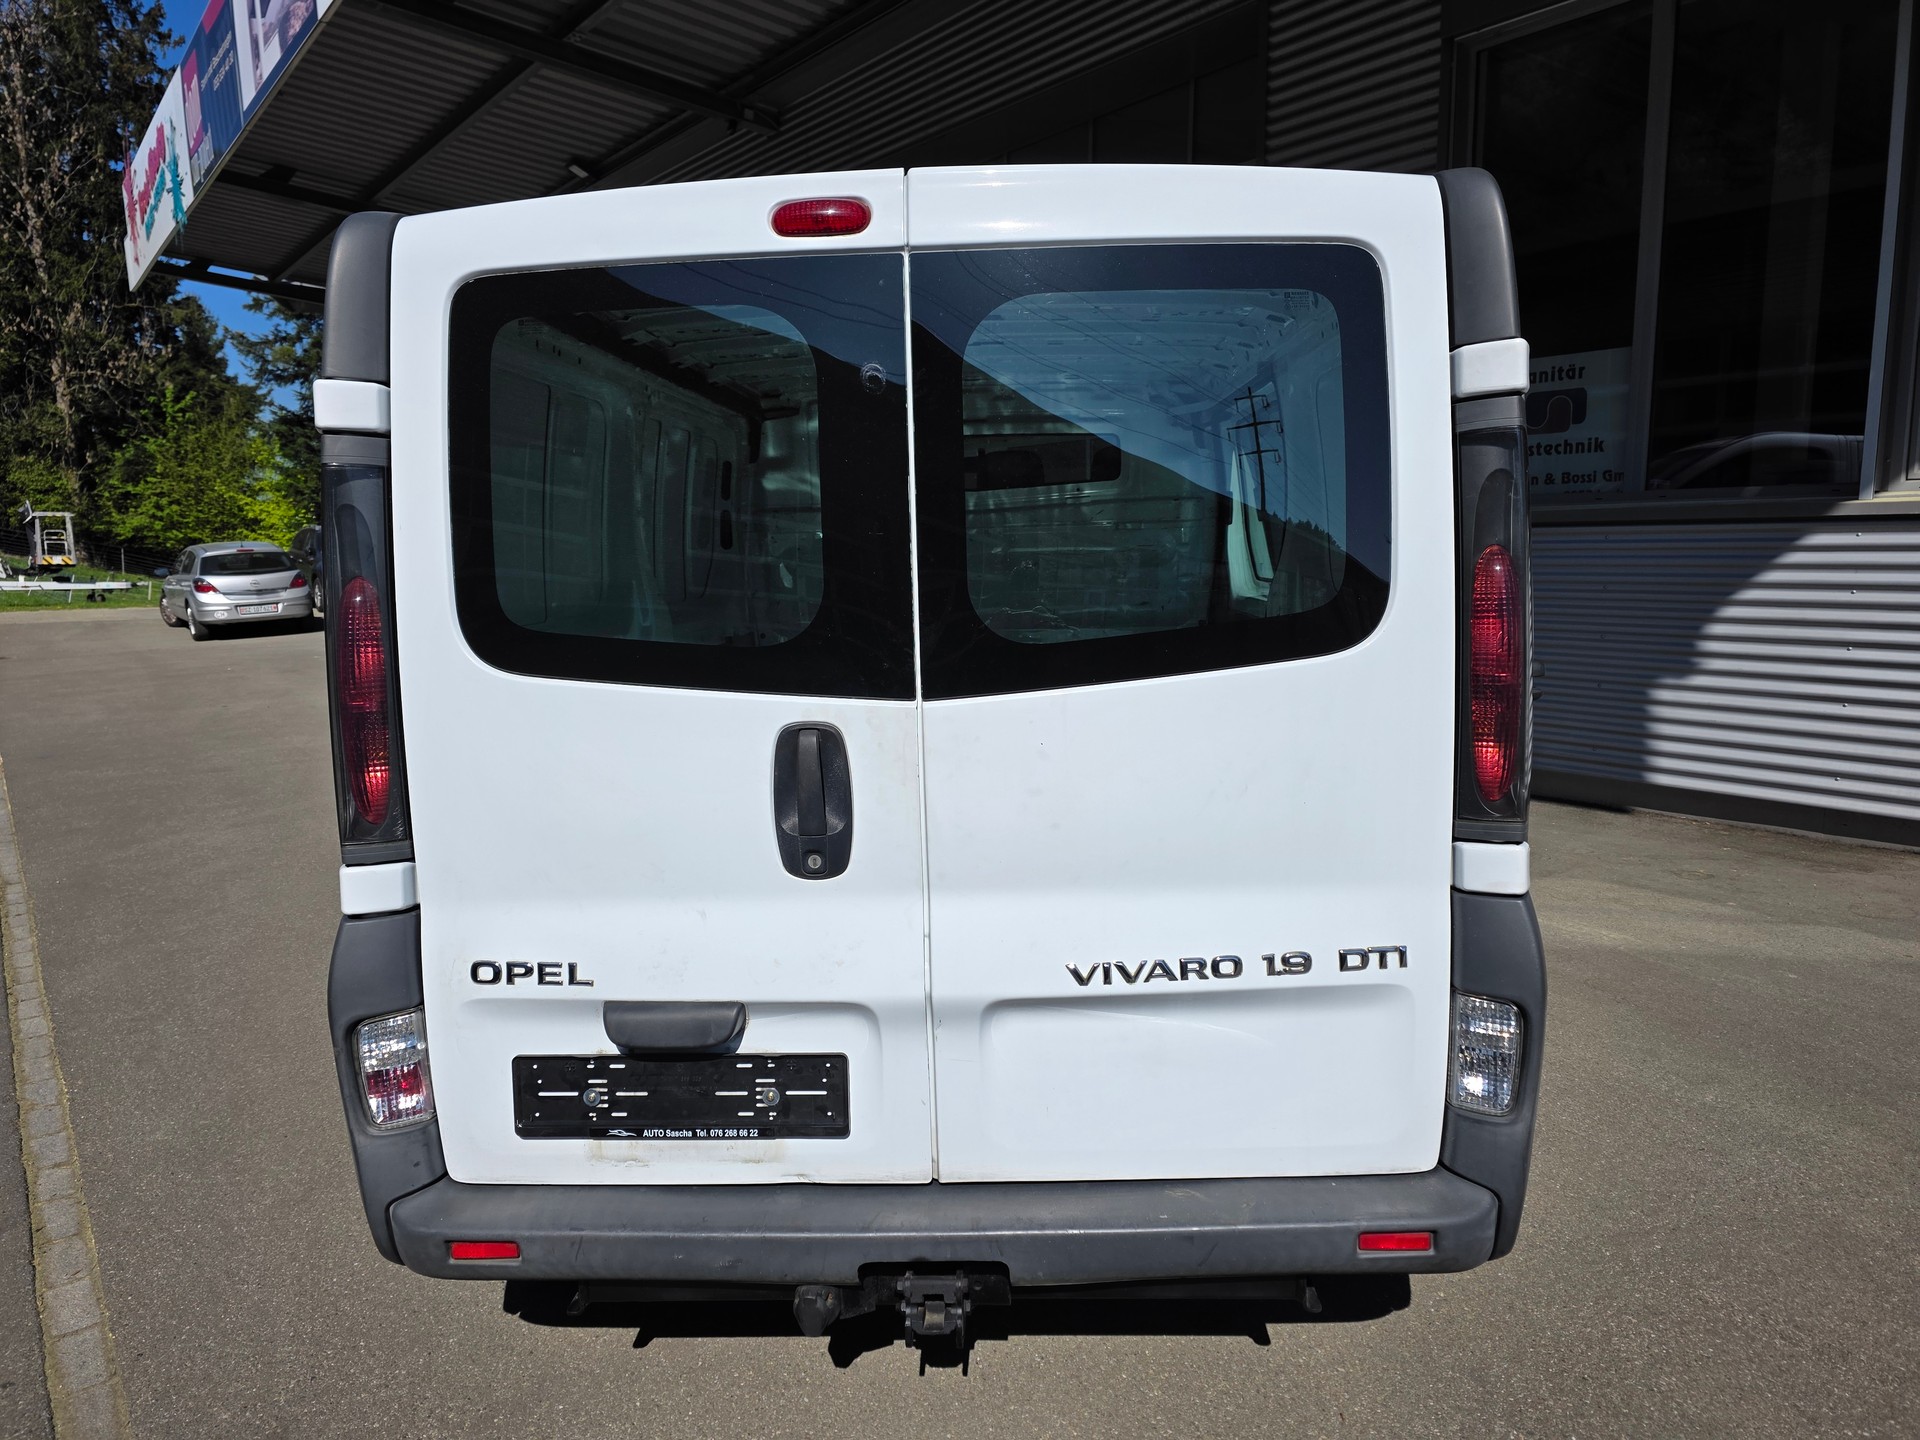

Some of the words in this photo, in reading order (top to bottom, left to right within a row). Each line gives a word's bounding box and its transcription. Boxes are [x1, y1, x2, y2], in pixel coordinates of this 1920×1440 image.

[1544, 472, 1555, 485] &
[1561, 470, 1597, 484] Bossi
[470, 960, 594, 987] OPEL
[1065, 955, 1243, 986] VIVARO
[1338, 945, 1408, 973] DTI
[643, 1129, 664, 1138] AUTO
[666, 1129, 692, 1138] Sascha
[696, 1129, 708, 1138] Tel.
[710, 1129, 723, 1138] 076
[724, 1129, 738, 1138] 268
[739, 1129, 748, 1138] 66
[749, 1129, 758, 1138] 22
